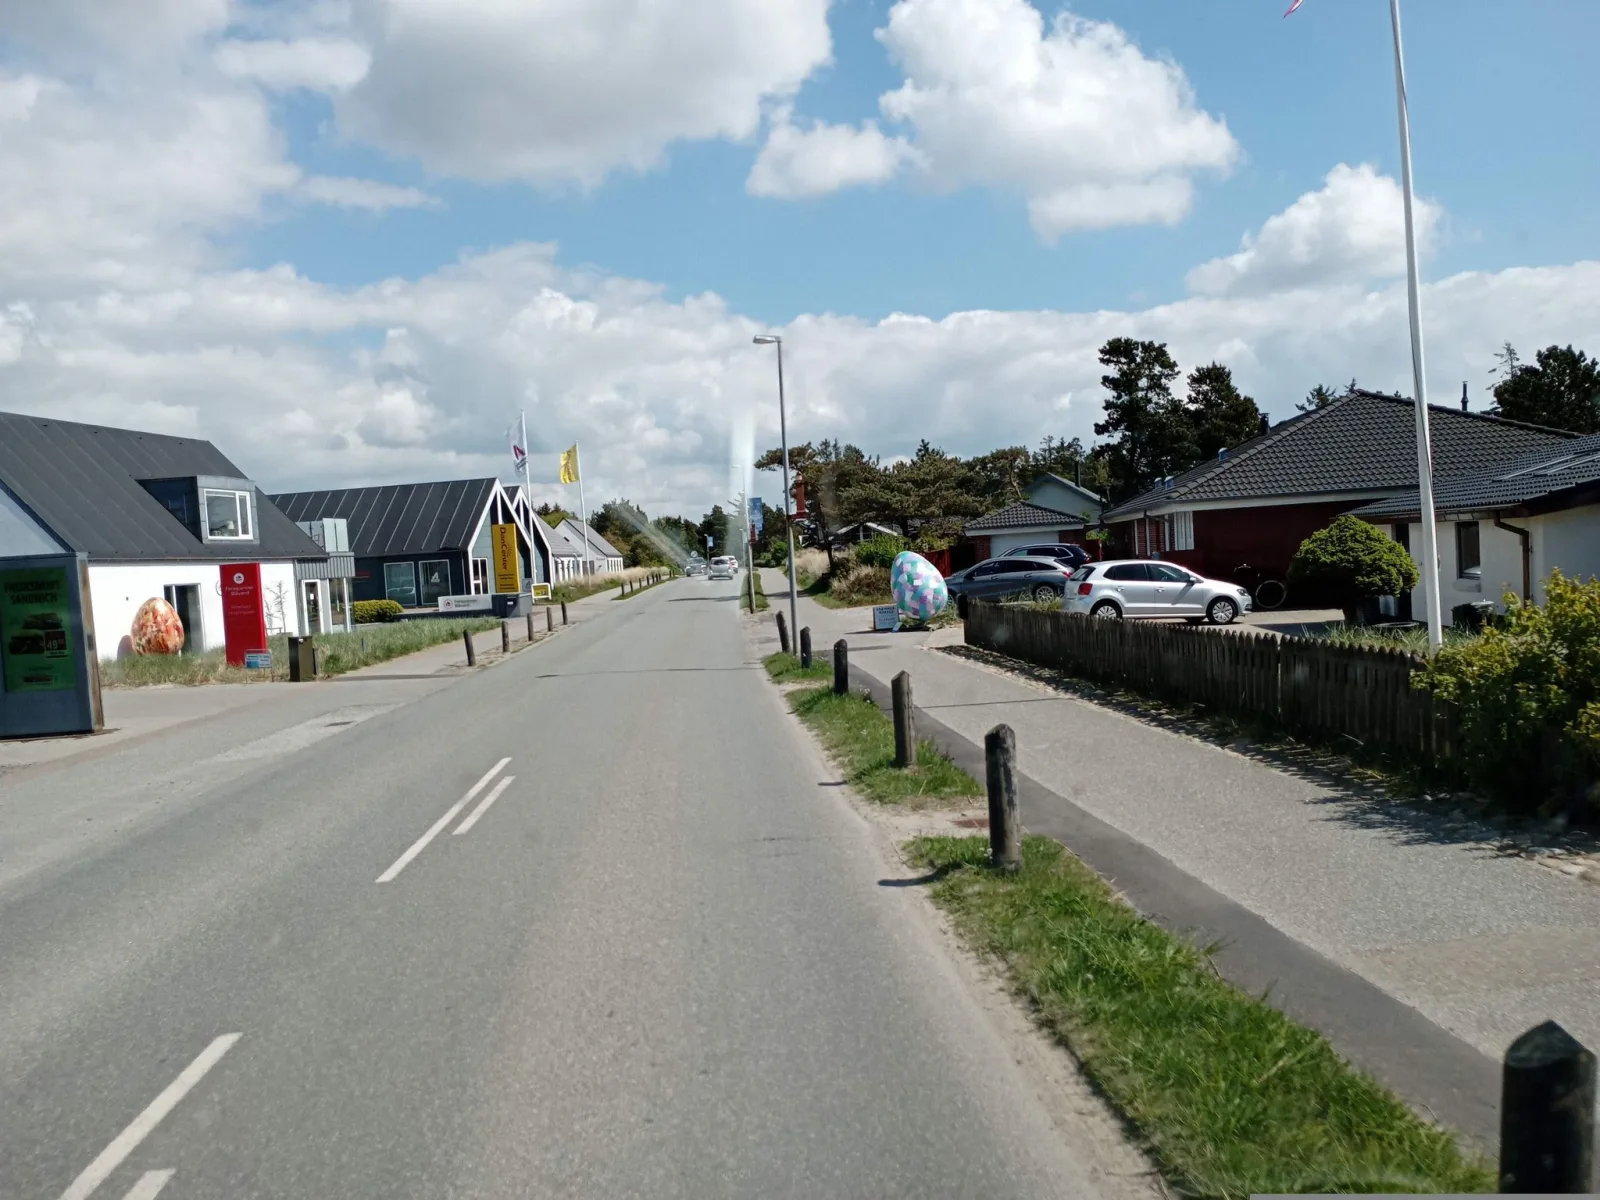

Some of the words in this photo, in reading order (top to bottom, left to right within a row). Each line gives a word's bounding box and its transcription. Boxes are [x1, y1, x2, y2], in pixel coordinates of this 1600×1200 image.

[500, 526, 508, 571] DanCenter
[10, 592, 58, 605] SANDWICH
[47, 639, 58, 650] 49
